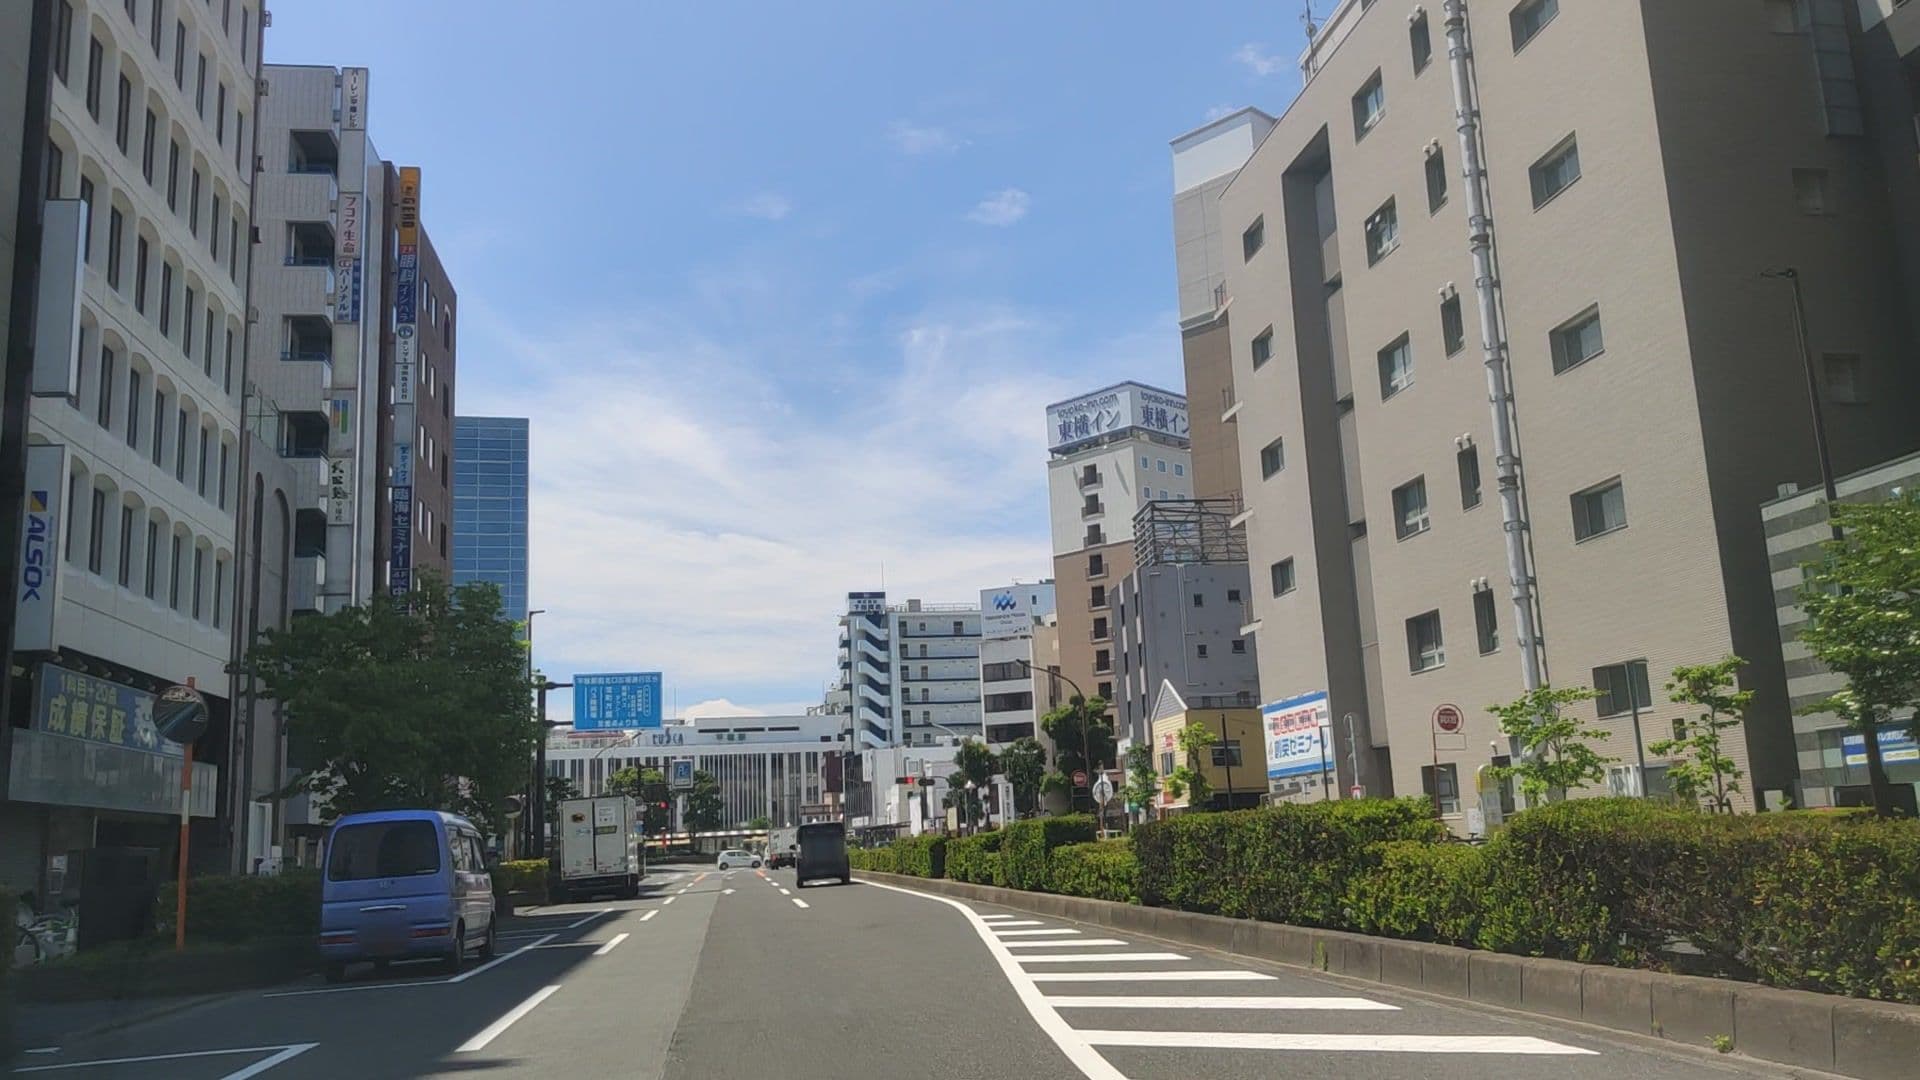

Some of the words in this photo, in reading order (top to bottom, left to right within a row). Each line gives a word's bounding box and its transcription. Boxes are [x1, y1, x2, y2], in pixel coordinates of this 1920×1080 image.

[343, 196, 357, 253] フコク生命
[1057, 393, 1120, 418] toyoko-inn.com
[1058, 409, 1121, 441] 東横イン
[1141, 404, 1190, 435] 東横イン
[22, 514, 46, 603] ALSOK
[48, 694, 127, 744] 成績保証
